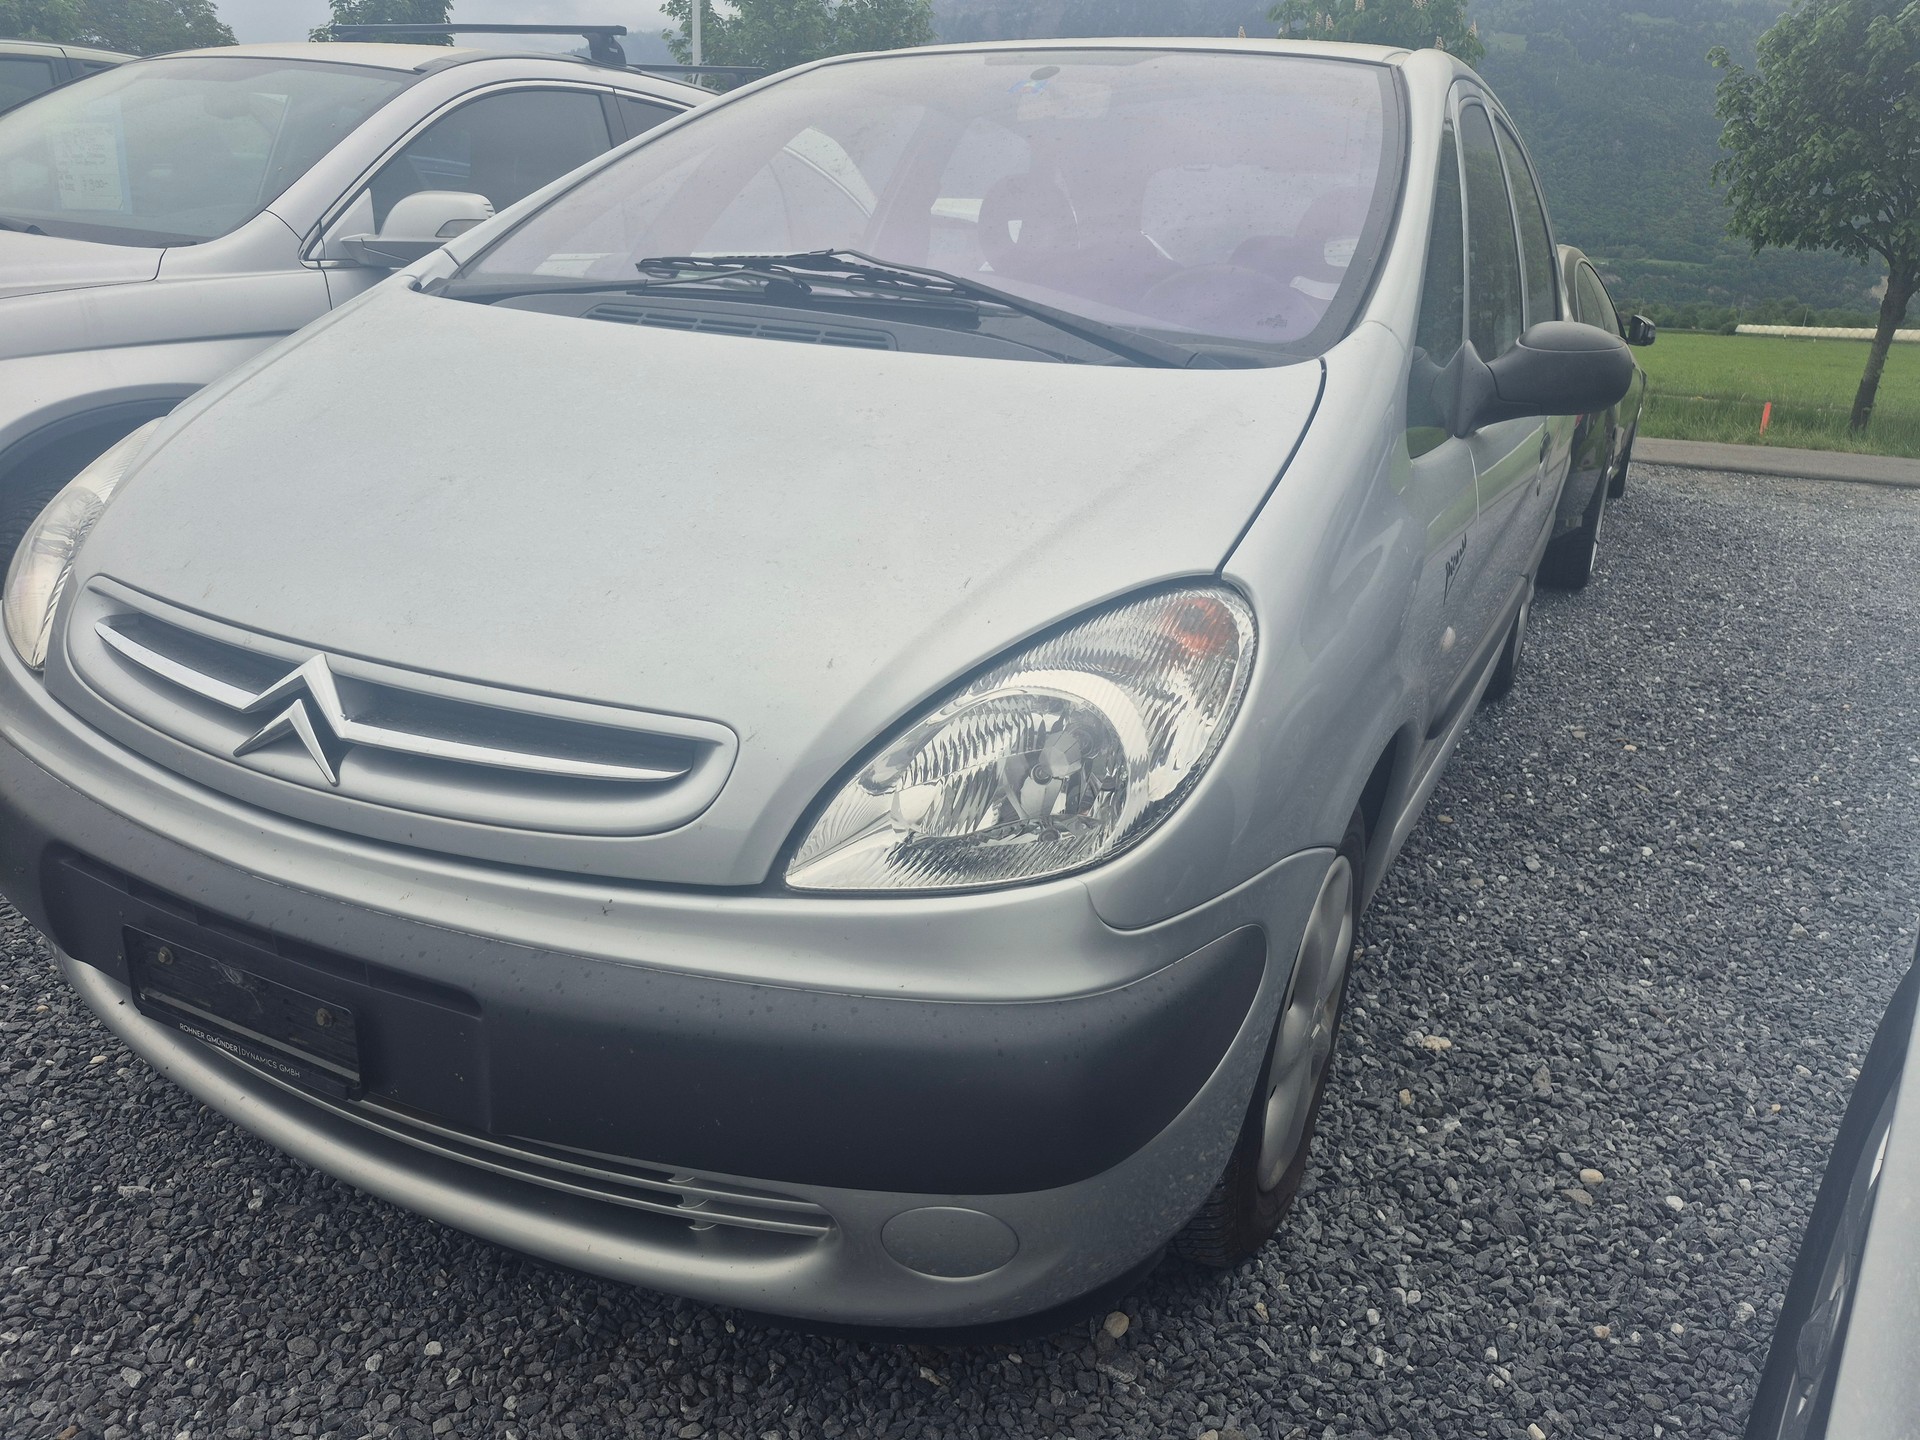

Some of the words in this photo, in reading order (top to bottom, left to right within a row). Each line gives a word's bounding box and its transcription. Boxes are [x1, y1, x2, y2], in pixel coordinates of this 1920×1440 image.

[179, 1022, 205, 1039] ROHNER
[241, 1048, 277, 1069] DYNAMICS
[279, 1063, 301, 1078] GMBH
